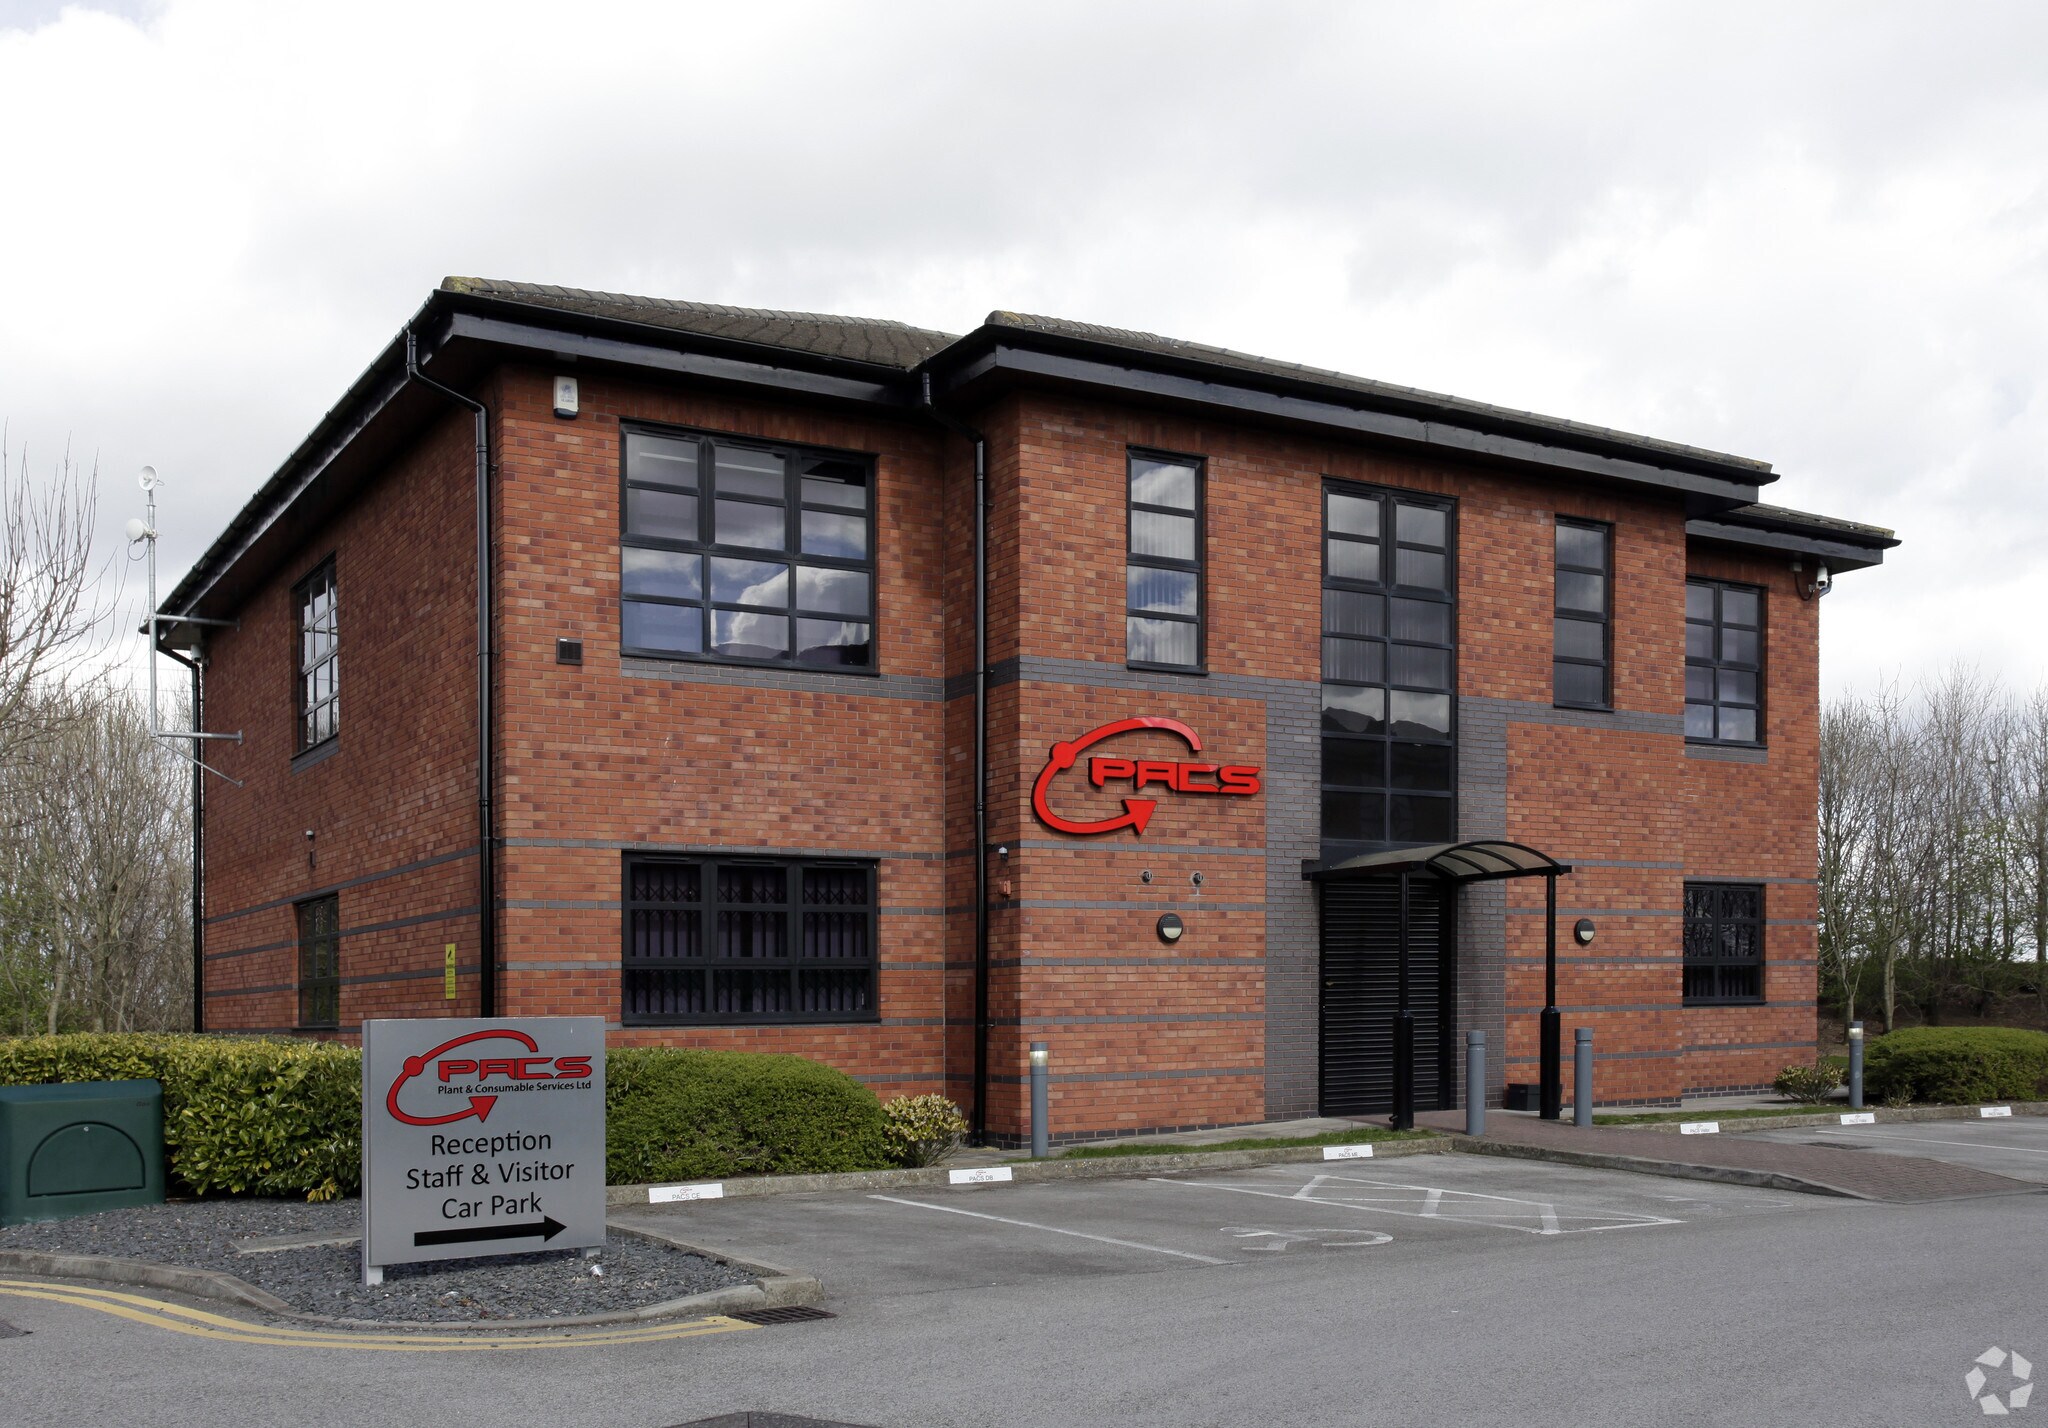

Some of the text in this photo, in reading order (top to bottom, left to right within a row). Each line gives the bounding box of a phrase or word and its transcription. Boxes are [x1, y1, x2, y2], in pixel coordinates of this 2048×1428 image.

[1088, 757, 1261, 795] PACS
[438, 1056, 592, 1082] PACS
[438, 1080, 592, 1094] Plant & Consumable Services Ltd
[431, 1130, 552, 1158] Reception
[406, 1160, 575, 1190] Staff & Visitor
[441, 1192, 542, 1219] Car Park
